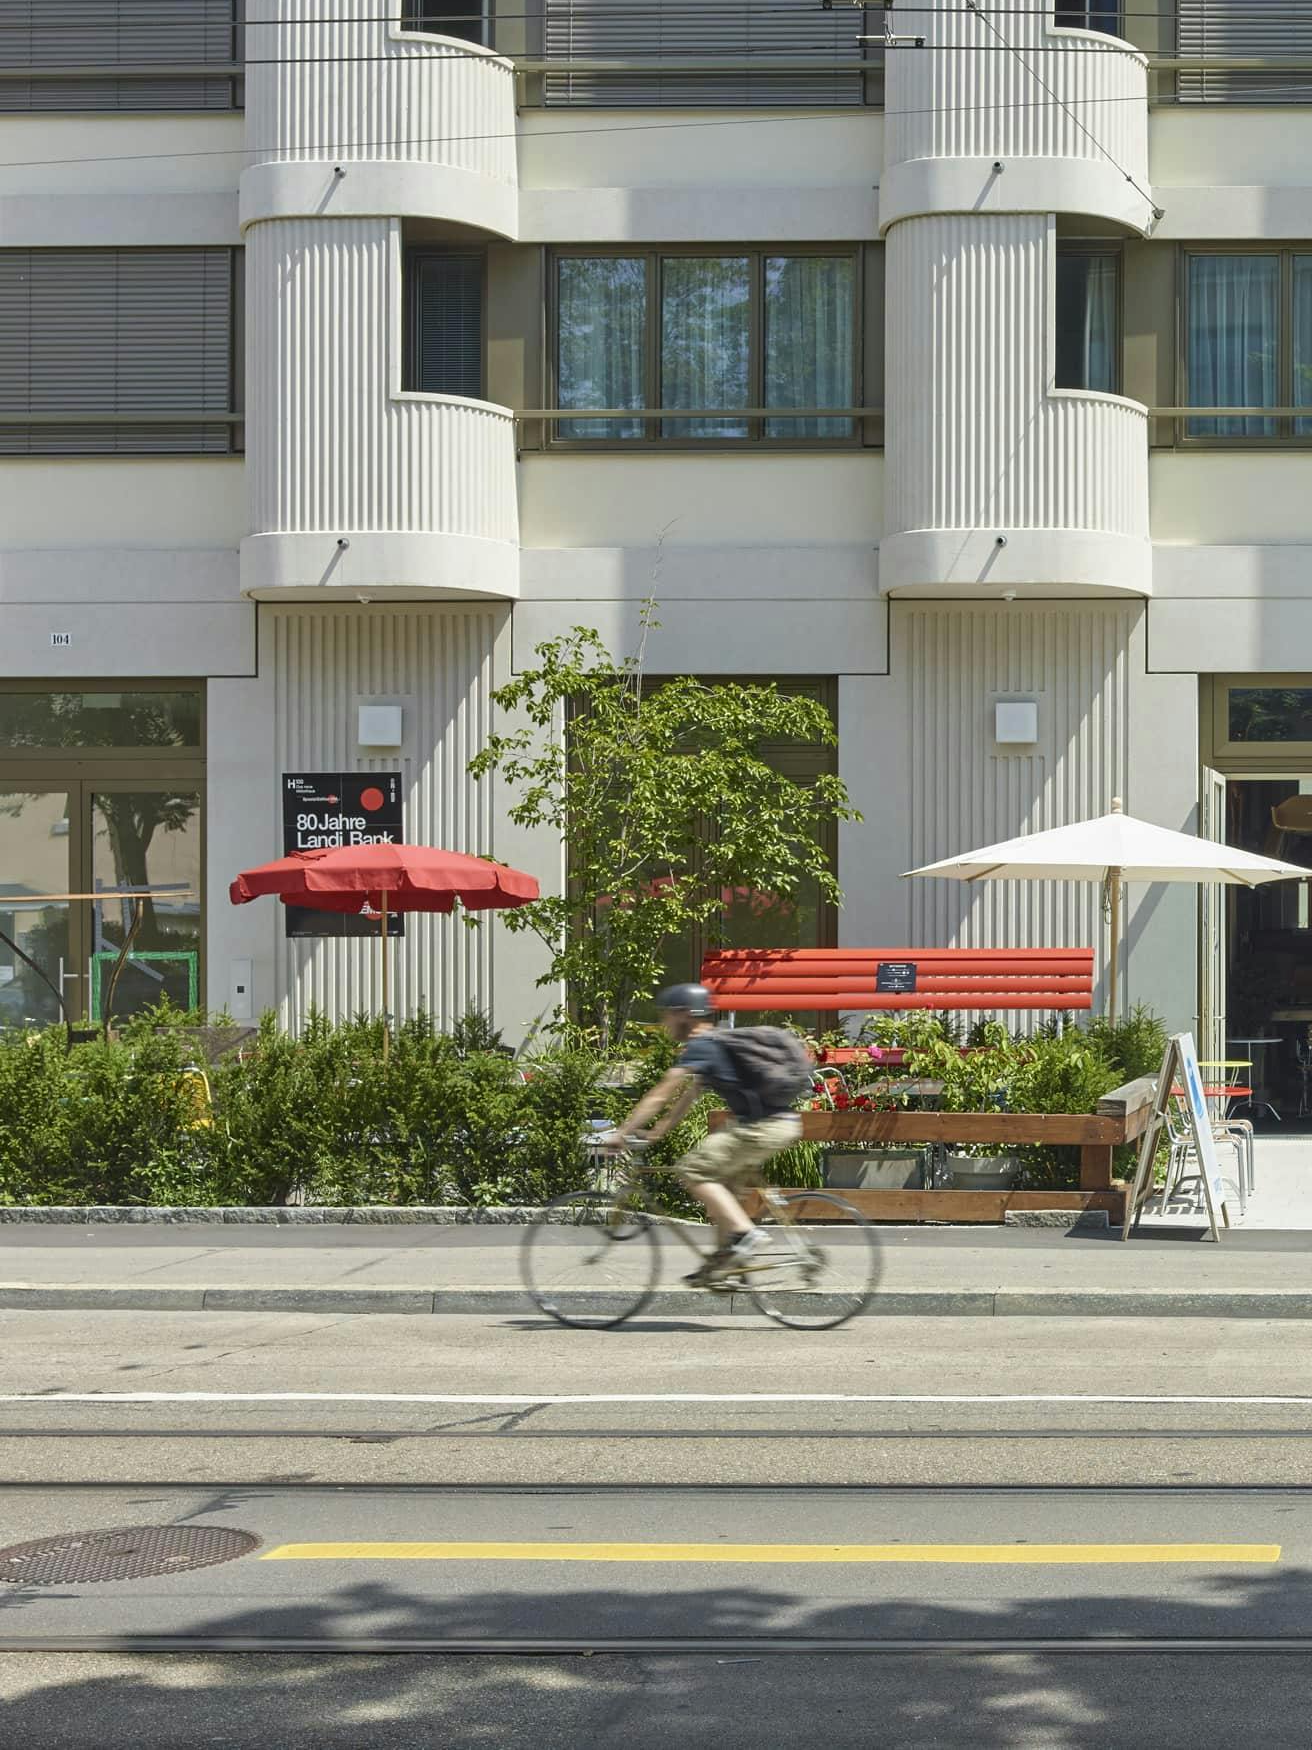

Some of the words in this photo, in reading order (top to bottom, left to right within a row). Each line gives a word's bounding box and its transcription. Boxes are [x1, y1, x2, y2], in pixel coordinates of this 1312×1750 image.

[287, 778, 296, 789] H
[296, 814, 318, 831] 80
[318, 813, 367, 831] Jahre
[297, 831, 343, 849] Landi
[349, 831, 394, 847] Bank
